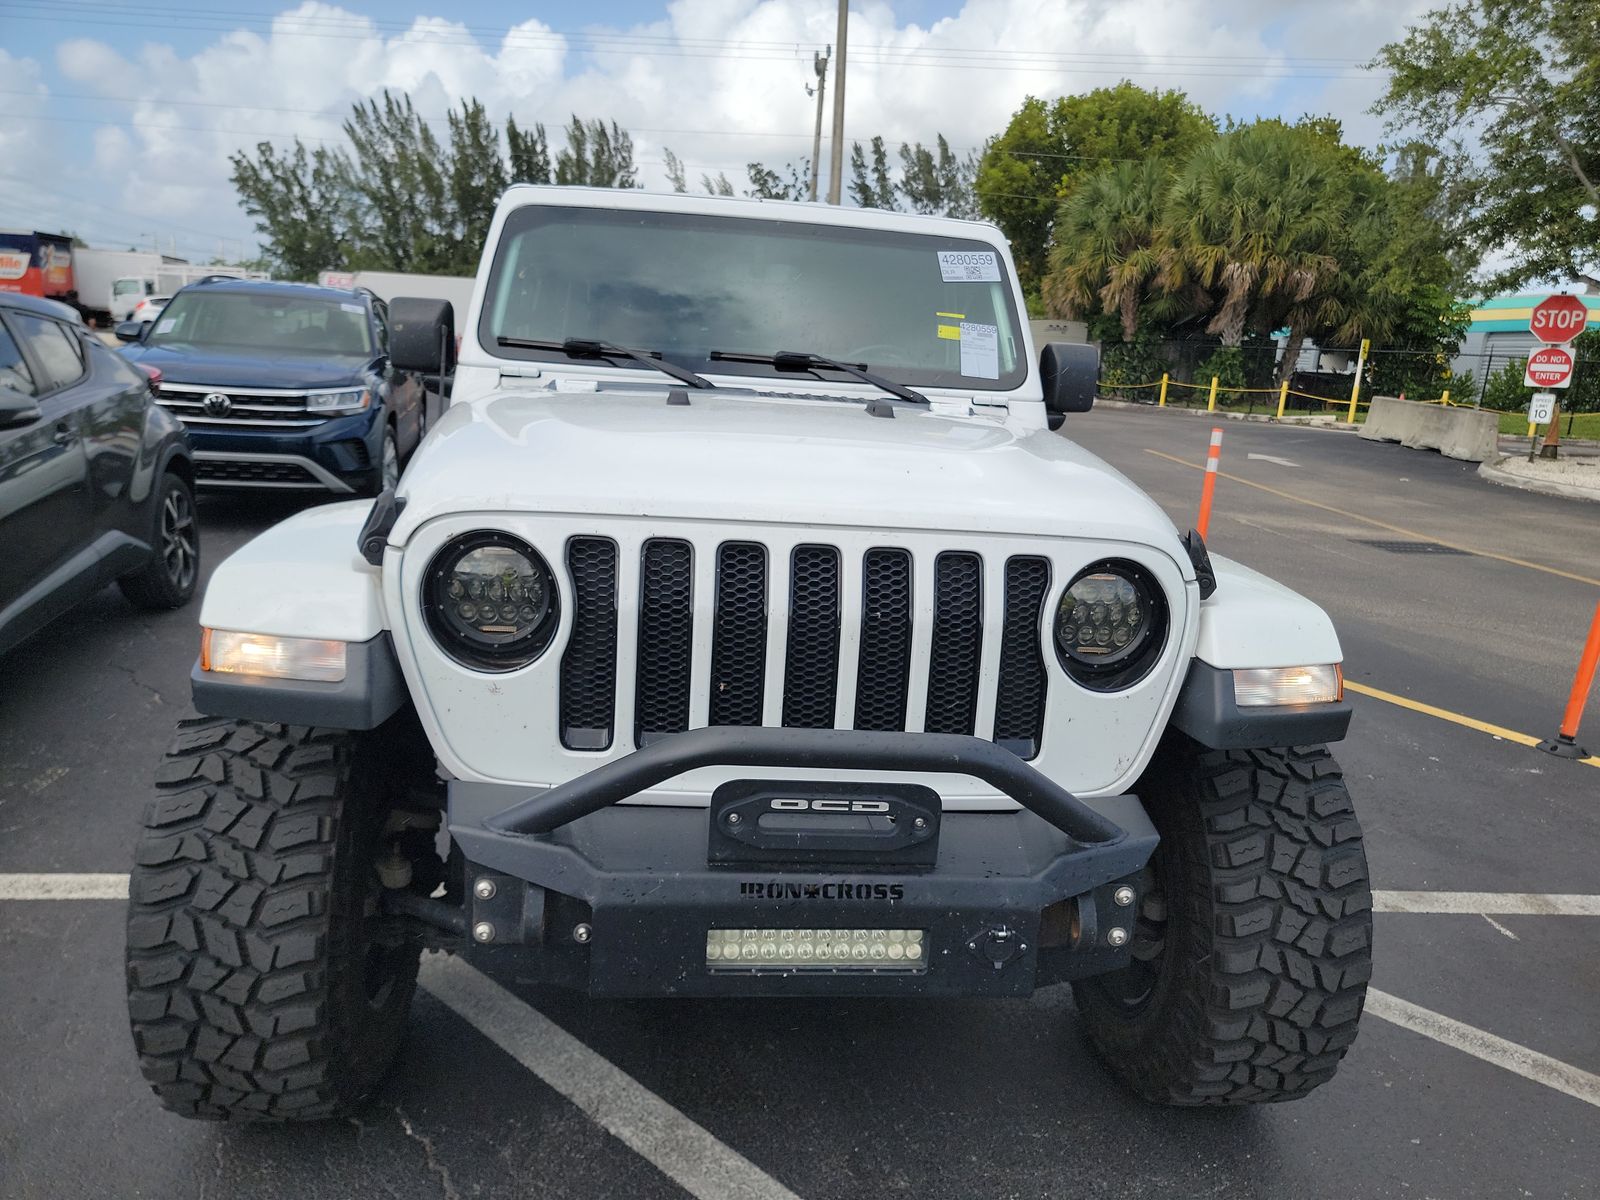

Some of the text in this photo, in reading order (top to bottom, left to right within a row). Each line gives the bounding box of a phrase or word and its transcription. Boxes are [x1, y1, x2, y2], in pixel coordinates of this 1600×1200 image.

[942, 254, 993, 265] 4280559
[1534, 309, 1584, 328] STOP
[1536, 355, 1566, 363] DO NOT
[1535, 372, 1561, 380] ENTER
[1535, 409, 1547, 419] 10
[770, 798, 890, 812] OCD
[822, 882, 904, 900] CROSS
